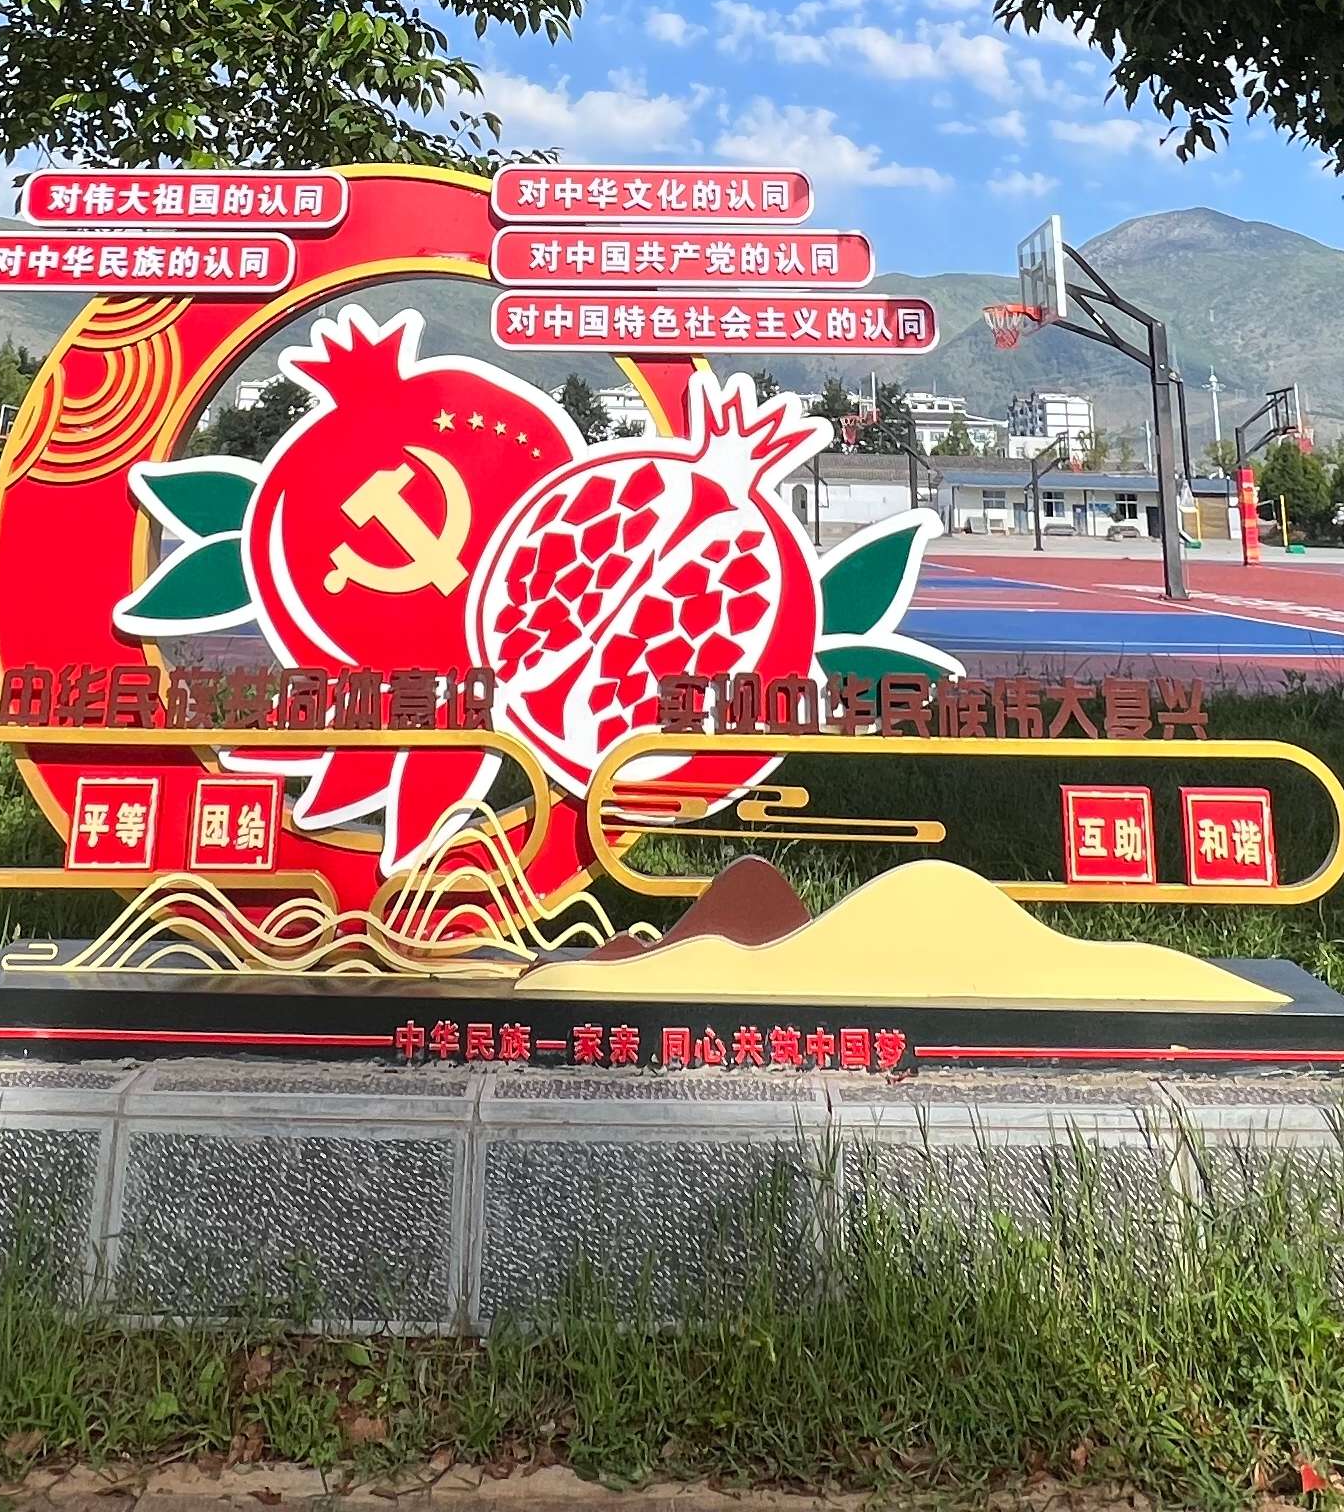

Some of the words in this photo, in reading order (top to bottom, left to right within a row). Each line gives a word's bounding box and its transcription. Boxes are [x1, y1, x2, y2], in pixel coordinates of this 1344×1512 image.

[48, 182, 324, 217] 对伟大祖国的认同
[518, 178, 791, 211] 对中华文化的认同
[529, 240, 841, 275] 对中国共产党的认同
[505, 303, 927, 341] 对中国特色社会主义的认同
[656, 673, 1210, 739] 实现中华民族伟大复兴
[77, 804, 149, 850] 平等
[199, 803, 268, 850] 团结
[1078, 818, 1144, 862] 互助
[1198, 818, 1264, 864] 和谐
[662, 1026, 906, 1068] 同心共筑中国梦
